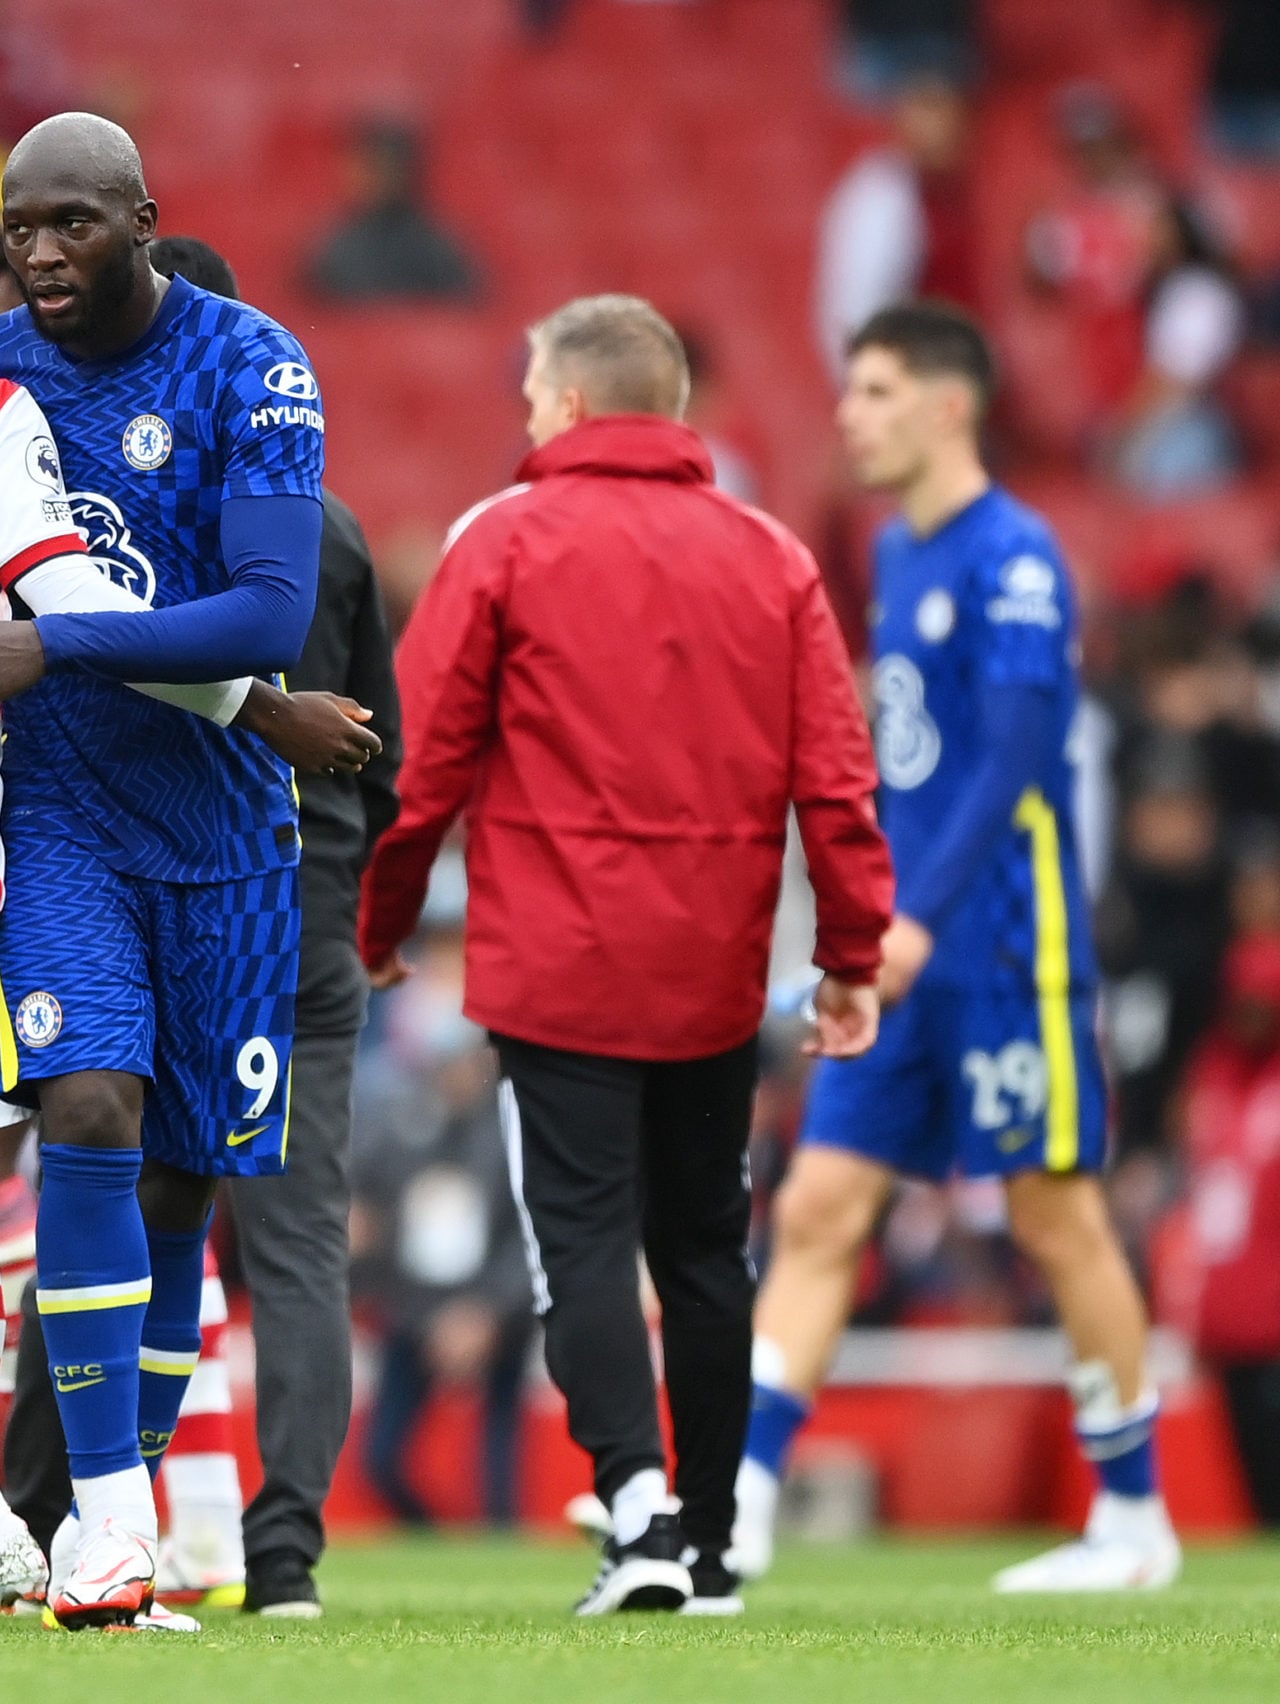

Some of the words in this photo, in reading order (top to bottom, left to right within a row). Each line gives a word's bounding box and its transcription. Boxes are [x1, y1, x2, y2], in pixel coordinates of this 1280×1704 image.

[251, 406, 325, 434] HYUNDA
[236, 1036, 279, 1119] 9
[962, 1041, 1047, 1129] 19
[53, 1363, 103, 1378] CFC
